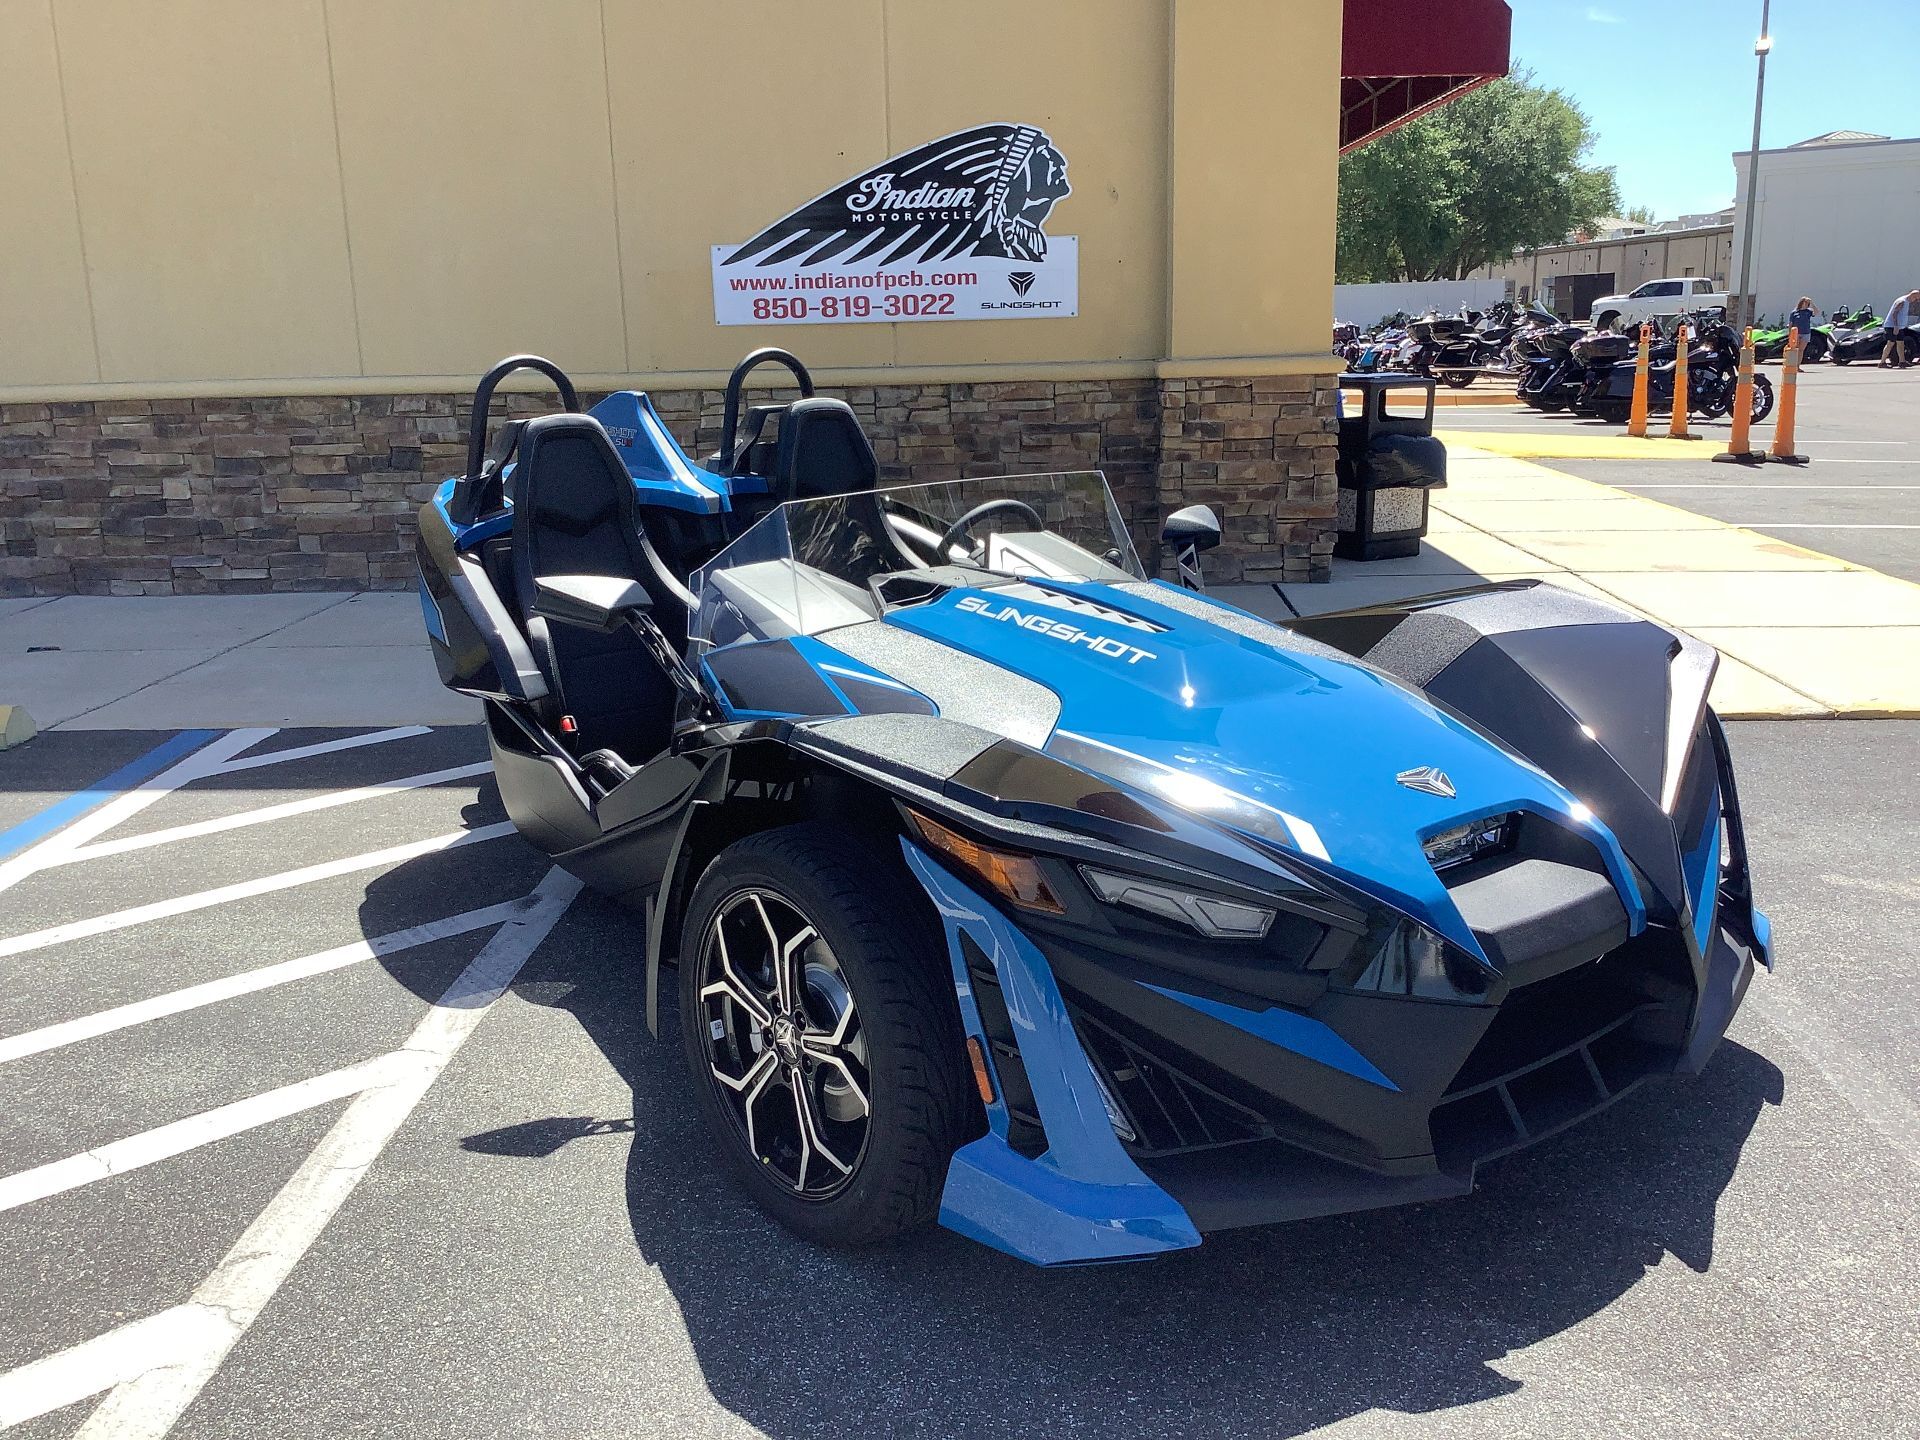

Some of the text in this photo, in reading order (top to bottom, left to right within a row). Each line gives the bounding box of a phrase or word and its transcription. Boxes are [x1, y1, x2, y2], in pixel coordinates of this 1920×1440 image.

[846, 174, 975, 212] Indian
[852, 211, 972, 223] MOTORCYCLE
[730, 271, 977, 292] www.indianofpcb.com
[753, 294, 955, 320] 850-819-3022
[981, 301, 1062, 309] SLINGSHOT
[605, 426, 637, 439] SHOT
[954, 597, 1157, 664] SLINGSHOT
